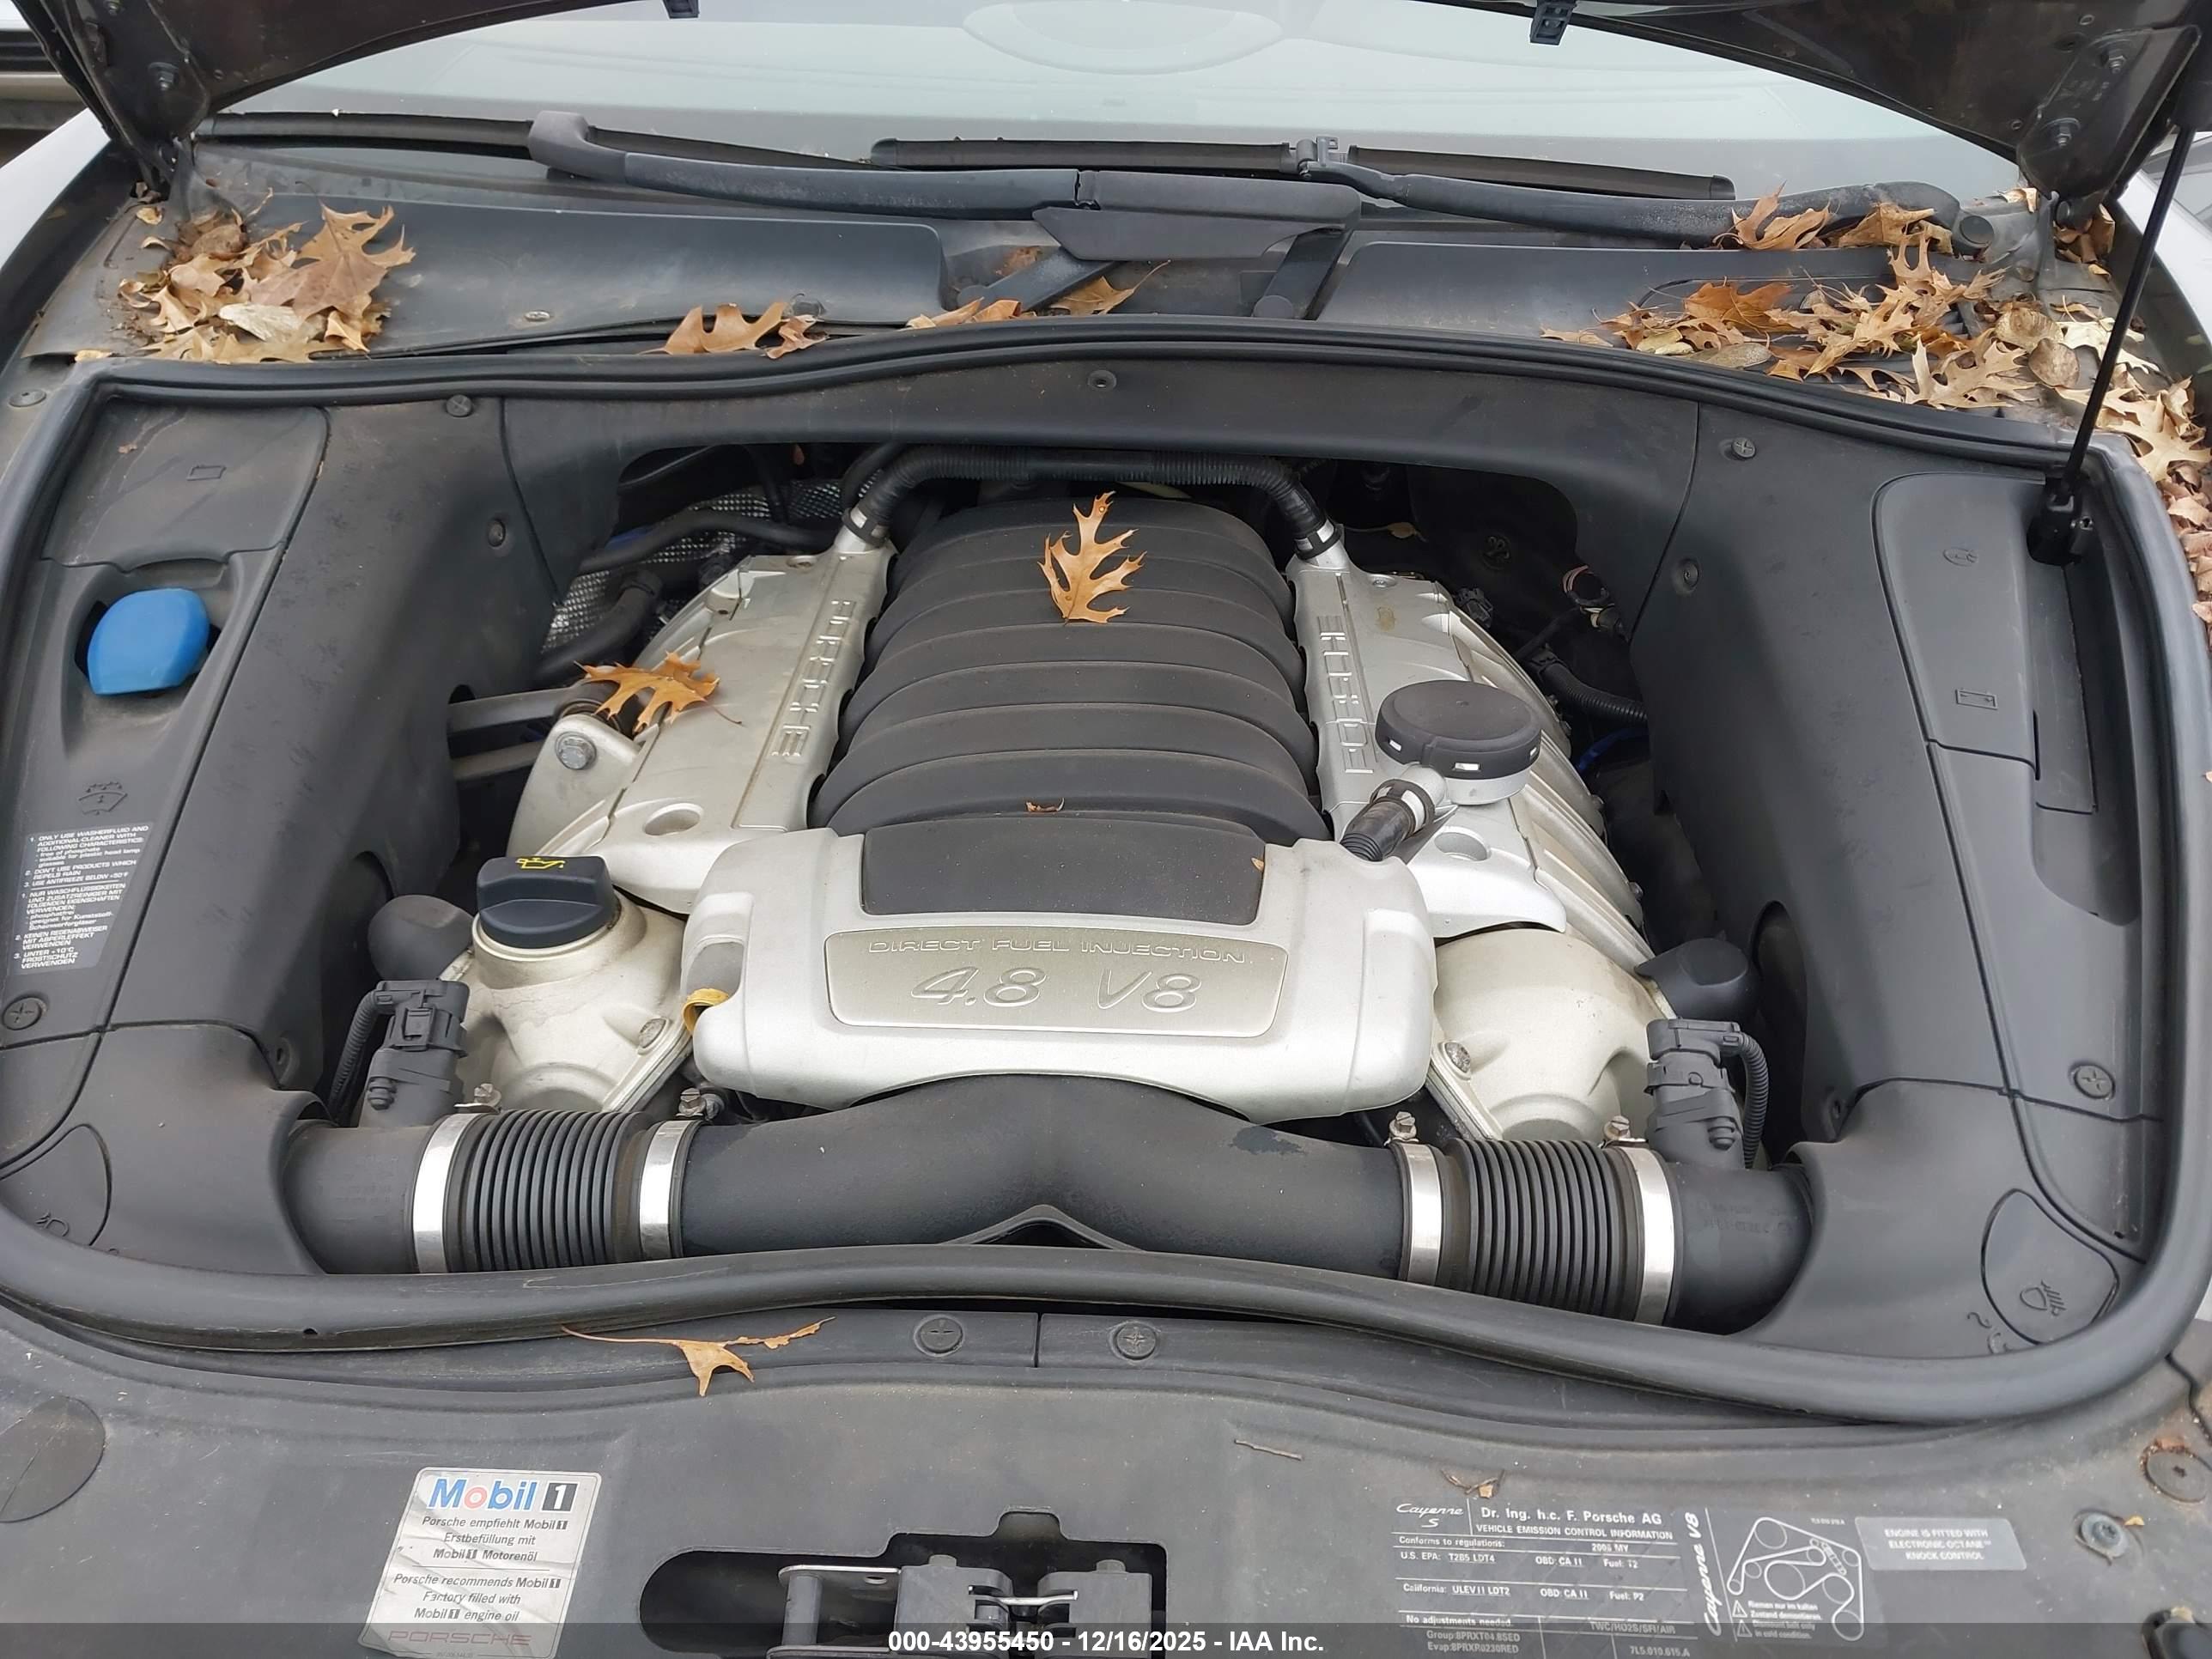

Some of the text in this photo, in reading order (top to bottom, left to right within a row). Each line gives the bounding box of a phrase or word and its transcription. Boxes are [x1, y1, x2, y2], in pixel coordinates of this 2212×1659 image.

[131, 824, 149, 833] AND
[37, 842, 77, 853] FOLLOWING
[72, 861, 110, 871] PRODUCTS
[112, 859, 136, 867] WHICH
[23, 949, 49, 957] UNTER
[869, 939, 1246, 964] DIRECT FUEL INJECTION
[21, 957, 75, 969] VERWENDEN
[910, 965, 1202, 1014] 4.8 V8
[428, 1478, 539, 1510] Mobil
[1395, 1503, 1464, 1519] Cayenne
[1480, 1506, 1662, 1525] Dr. Ing. h.c. F. Porsche AG
[422, 1516, 466, 1528] Porsche
[470, 1517, 520, 1530] empfiehlt
[1420, 1517, 1440, 1528] S
[1475, 1523, 1674, 1540] VEHICLE EMISSION CONTROL INFORMATION
[1884, 1528, 1989, 1538] ENGINE IS FITTED WITH
[444, 1532, 537, 1547] Erstbefüllung mit
[1399, 1535, 1440, 1546] Conforms
[1443, 1537, 1452, 1546] to
[1888, 1540, 1945, 1549] ELECTRONIC
[482, 1549, 538, 1562] Motorenöl
[1401, 1551, 1419, 1560] U.S.
[1421, 1552, 1442, 1561] EPA:
[1473, 1553, 1496, 1563] LDT4
[1905, 1551, 1984, 1560] KNOCK CONTROL
[1684, 1511, 1723, 1637] Cayenne V8
[392, 1573, 439, 1585] Porsche
[441, 1576, 514, 1589] recommends
[1403, 1583, 1447, 1594] California:
[467, 1592, 496, 1604] filled
[498, 1593, 521, 1605] with
[464, 1609, 501, 1622] engine
[505, 1609, 520, 1622] oil
[1406, 1614, 1419, 1624] No
[1423, 1615, 1475, 1626] adjustments
[387, 1630, 532, 1646] PORSCHE
